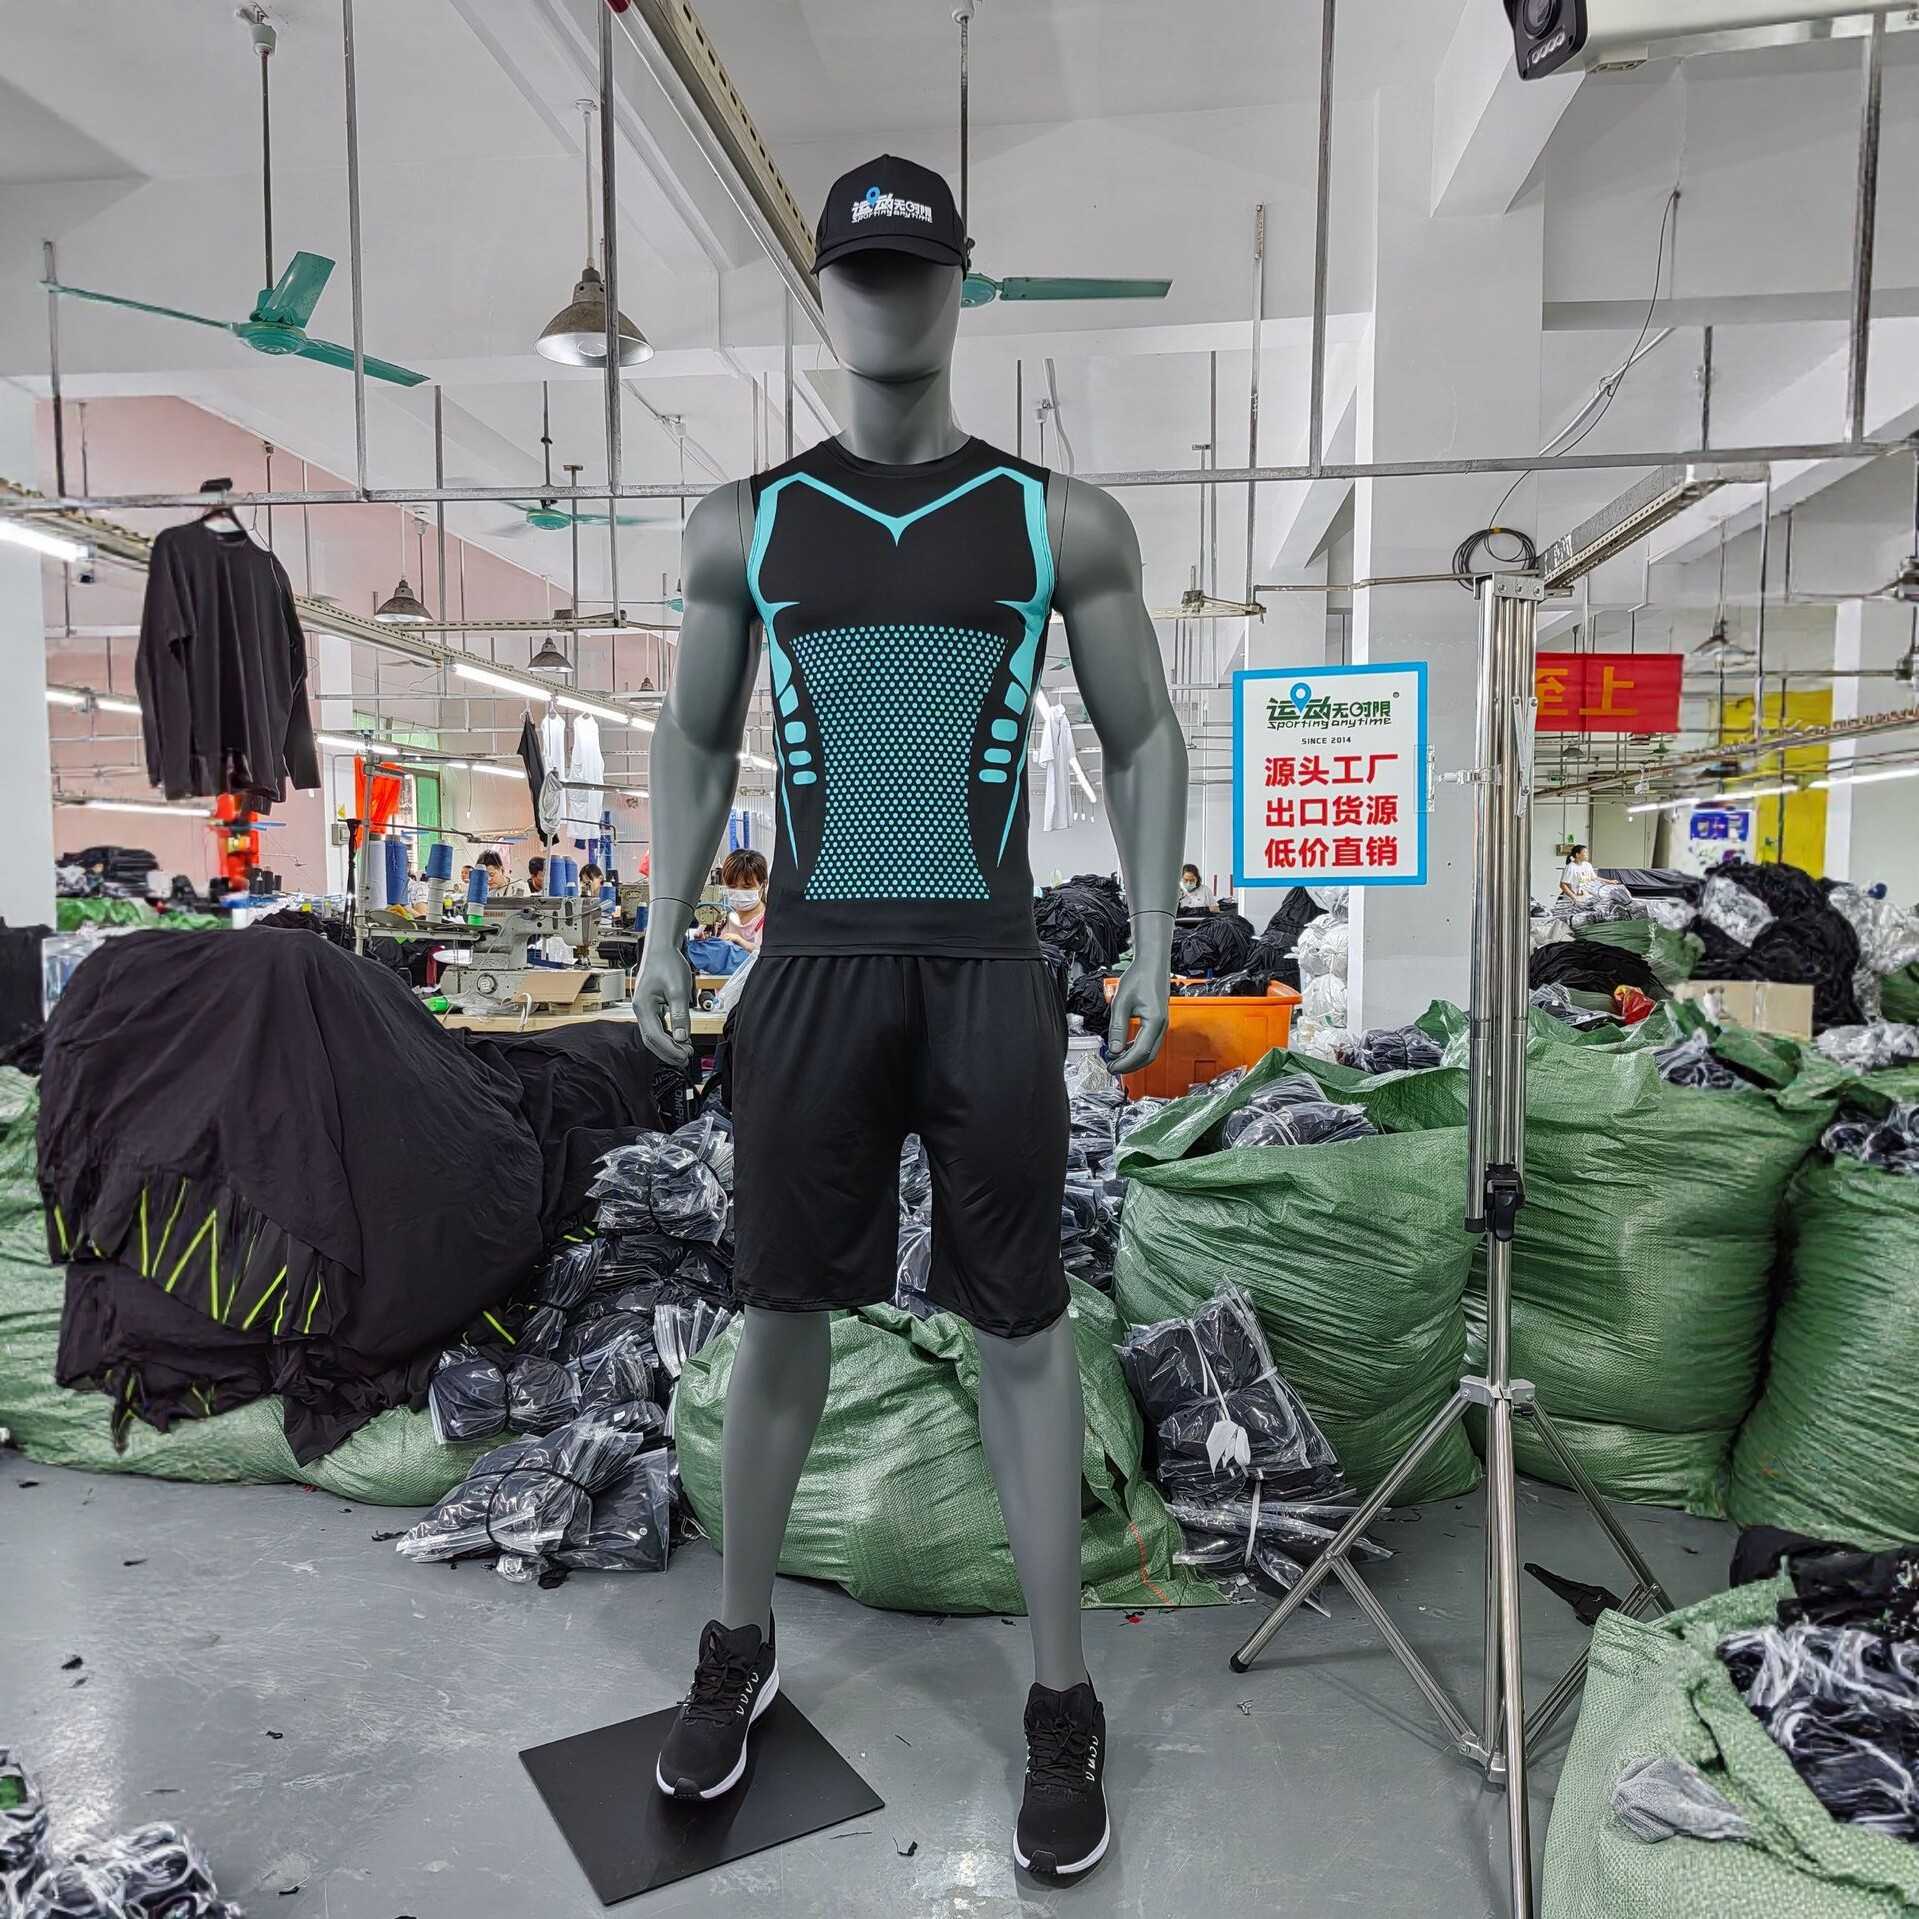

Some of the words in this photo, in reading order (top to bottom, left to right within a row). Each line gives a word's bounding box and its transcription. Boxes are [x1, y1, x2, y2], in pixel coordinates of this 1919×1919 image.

[1266, 695, 1391, 720] 运动无时限
[1301, 737, 1327, 745] SINCE
[1331, 736, 1352, 744] 2014
[1265, 754, 1399, 787] 源头工厂
[1265, 795, 1399, 828] 出口货源
[1264, 836, 1398, 869] 低价直销
